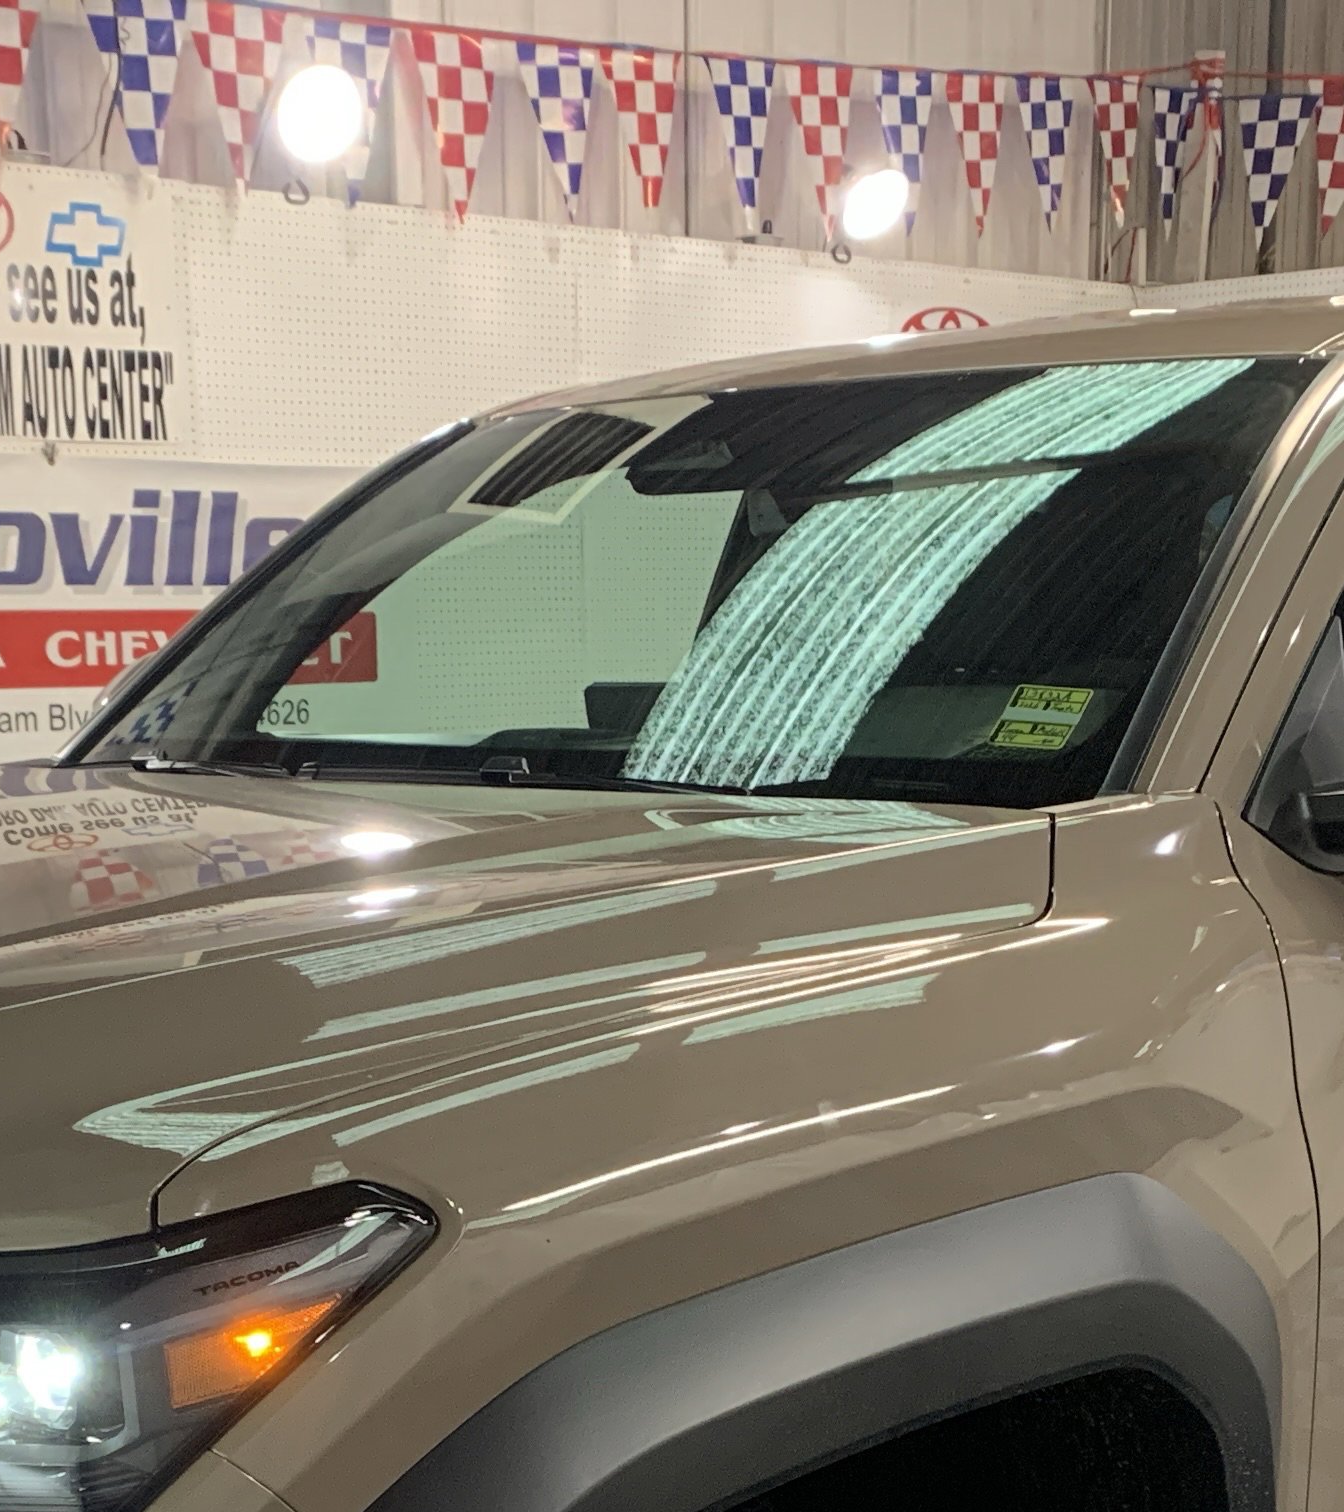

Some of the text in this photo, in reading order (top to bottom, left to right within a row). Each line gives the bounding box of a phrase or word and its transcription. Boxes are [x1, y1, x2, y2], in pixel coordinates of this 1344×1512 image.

[7, 263, 57, 324] see
[67, 267, 99, 325] us
[110, 252, 146, 346] at,
[22, 343, 76, 439] AUTO
[83, 346, 173, 440] CENTER"
[48, 703, 94, 731] Blv
[193, 1260, 301, 1297] TACOMA
